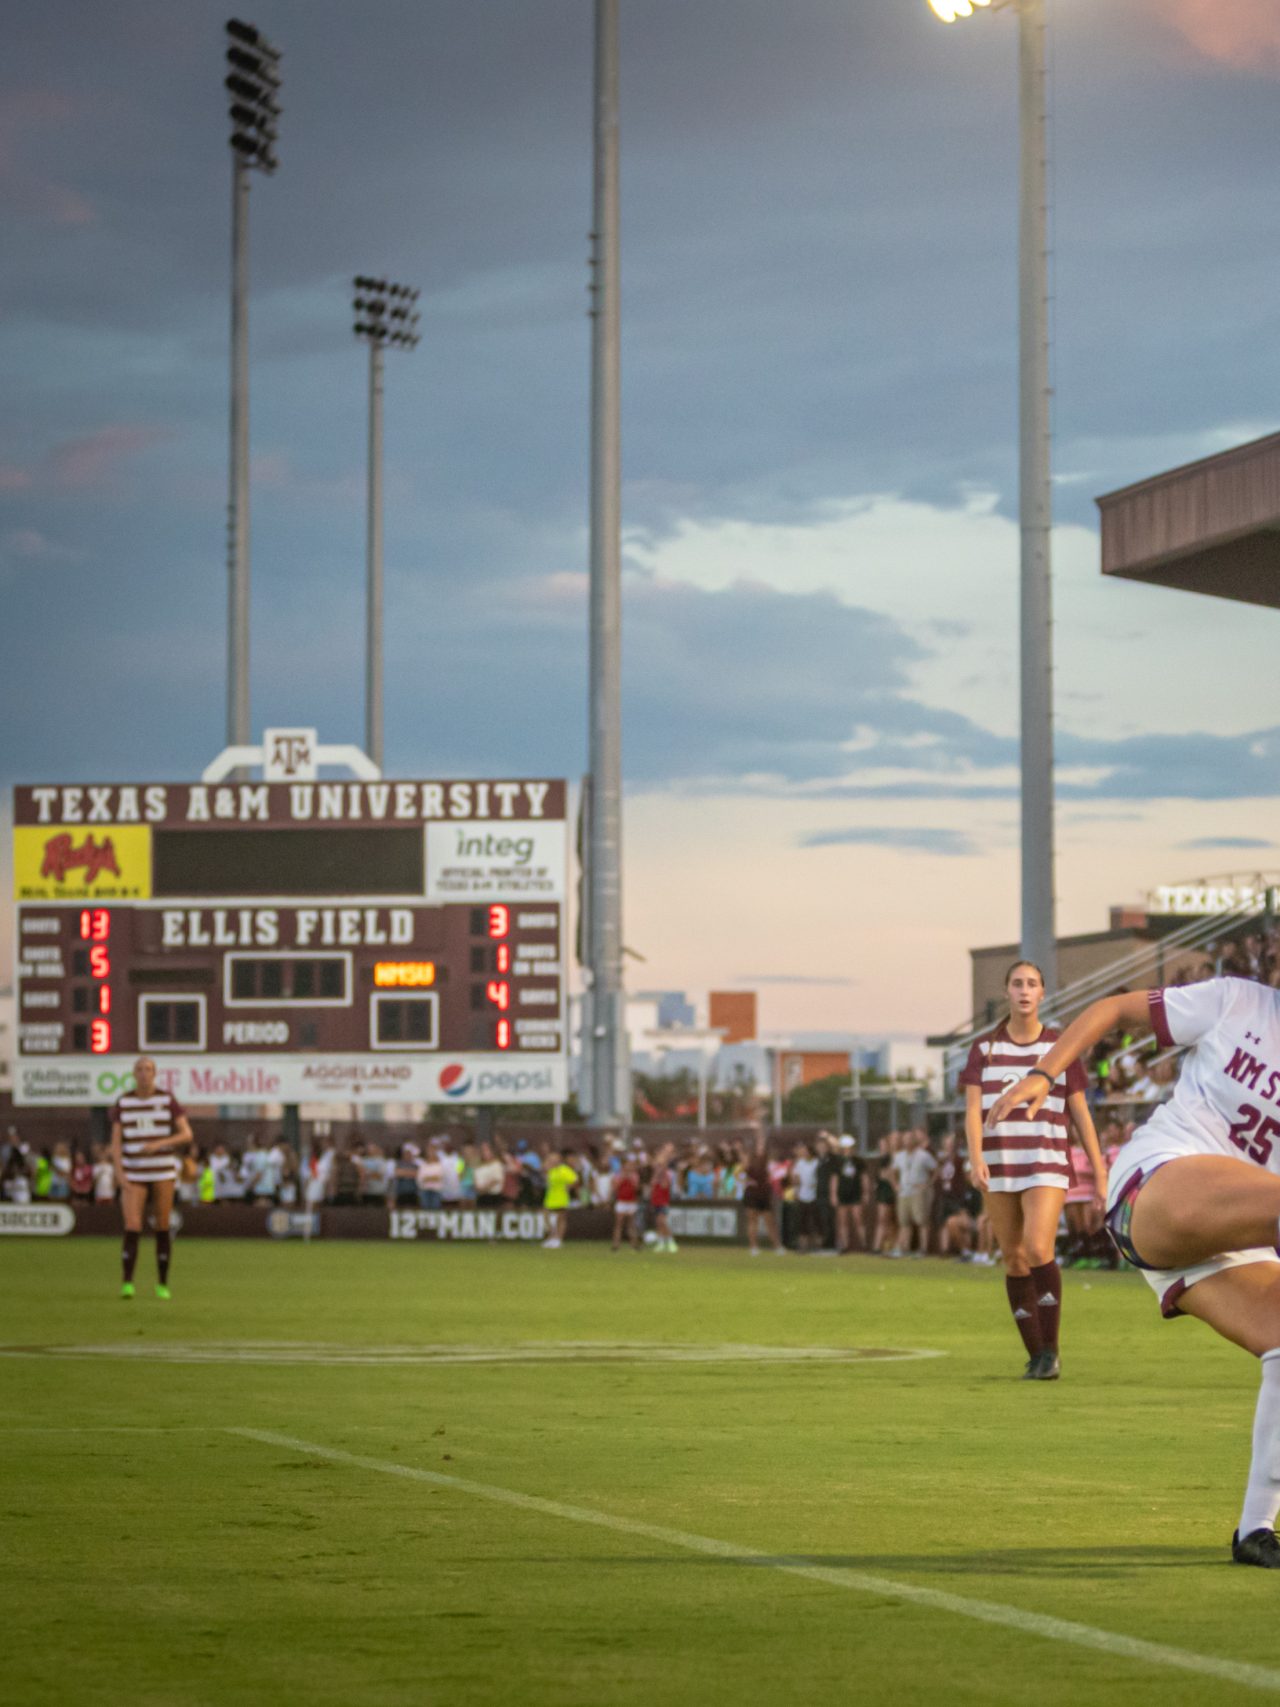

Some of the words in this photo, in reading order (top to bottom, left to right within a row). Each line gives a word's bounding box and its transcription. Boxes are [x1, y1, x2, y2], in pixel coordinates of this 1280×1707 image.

[32, 786, 168, 823] TEXAS
[186, 786, 269, 822] A&M
[289, 783, 549, 820] UNIVERSITY
[456, 829, 534, 865] integ
[1158, 886, 1234, 912] TEXAS
[80, 908, 110, 941] 13
[162, 911, 279, 946] ELLIS
[296, 910, 414, 945] FIELD
[488, 904, 510, 940] 3
[90, 943, 111, 979] 5
[496, 943, 511, 974] 1
[100, 983, 111, 1015] 1
[486, 980, 510, 1010] 4
[91, 1017, 111, 1054] 3
[223, 1021, 289, 1045] PERIOD
[496, 1017, 511, 1050] 1
[303, 1064, 412, 1080] AGGIELAND
[478, 1066, 553, 1094] pepsi
[1223, 1048, 1267, 1090] NM
